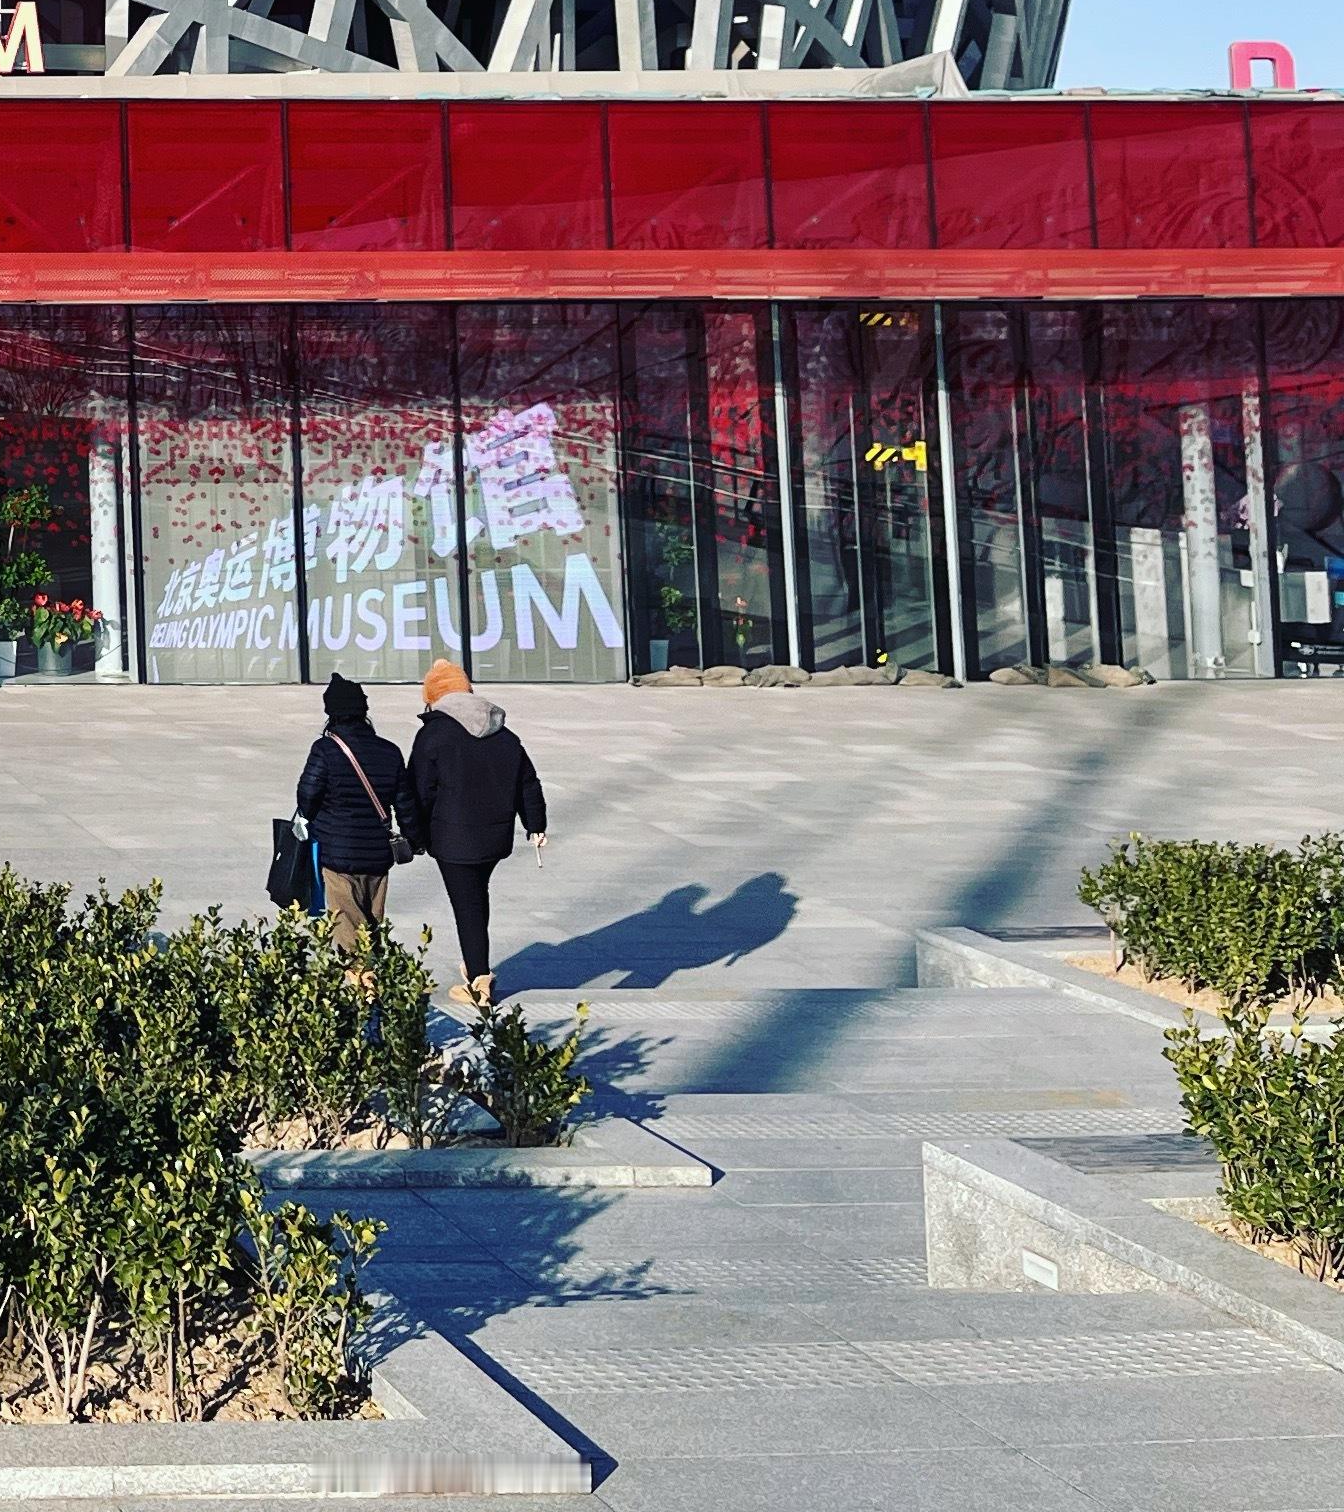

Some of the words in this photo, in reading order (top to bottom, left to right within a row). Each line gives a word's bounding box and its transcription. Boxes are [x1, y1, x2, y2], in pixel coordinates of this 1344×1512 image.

[157, 402, 585, 619] 北京奥运博物馆
[149, 618, 190, 648] BEIJING
[188, 604, 275, 650] OLYMPIC
[278, 553, 624, 652] MUSEUM
